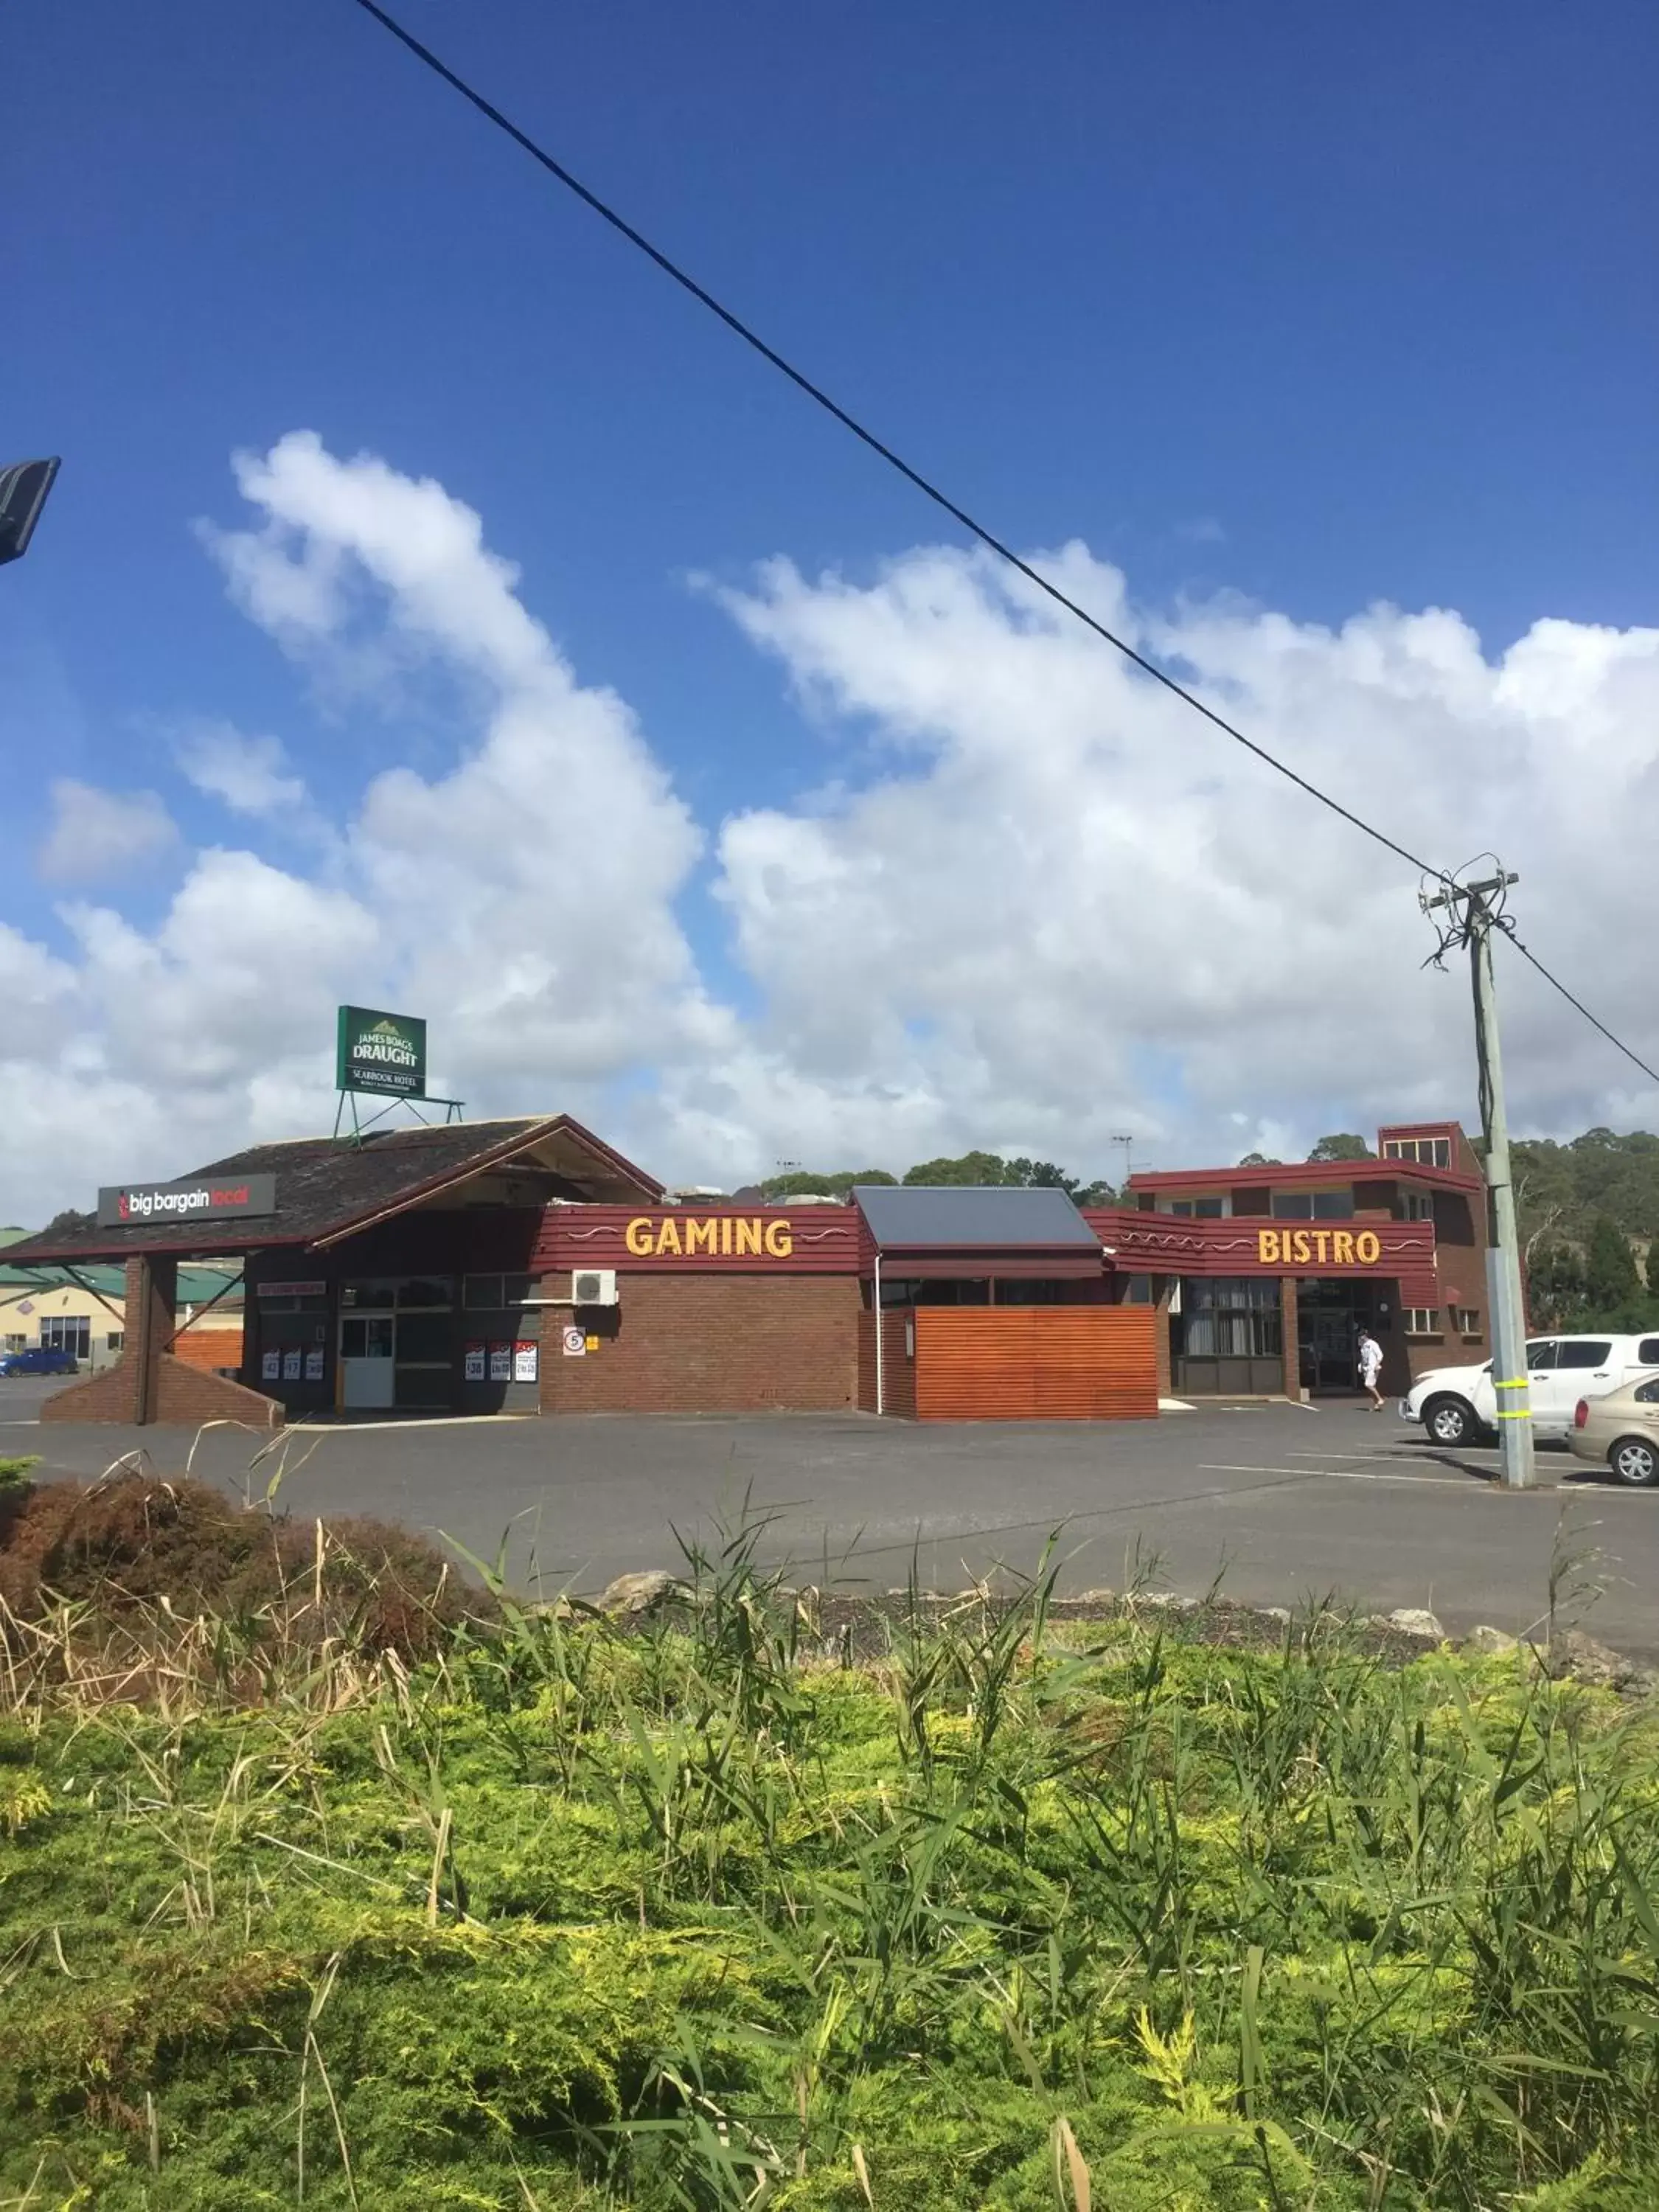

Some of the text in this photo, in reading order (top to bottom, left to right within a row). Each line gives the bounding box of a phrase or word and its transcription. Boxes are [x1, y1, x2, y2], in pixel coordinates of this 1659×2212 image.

[353, 1044, 418, 1067] DRAUGHT
[129, 1193, 152, 1216] big
[153, 1188, 209, 1213] bargain
[626, 1217, 793, 1258] GAMING
[1259, 1229, 1380, 1265] BISTRO
[571, 1335, 579, 1346] 5
